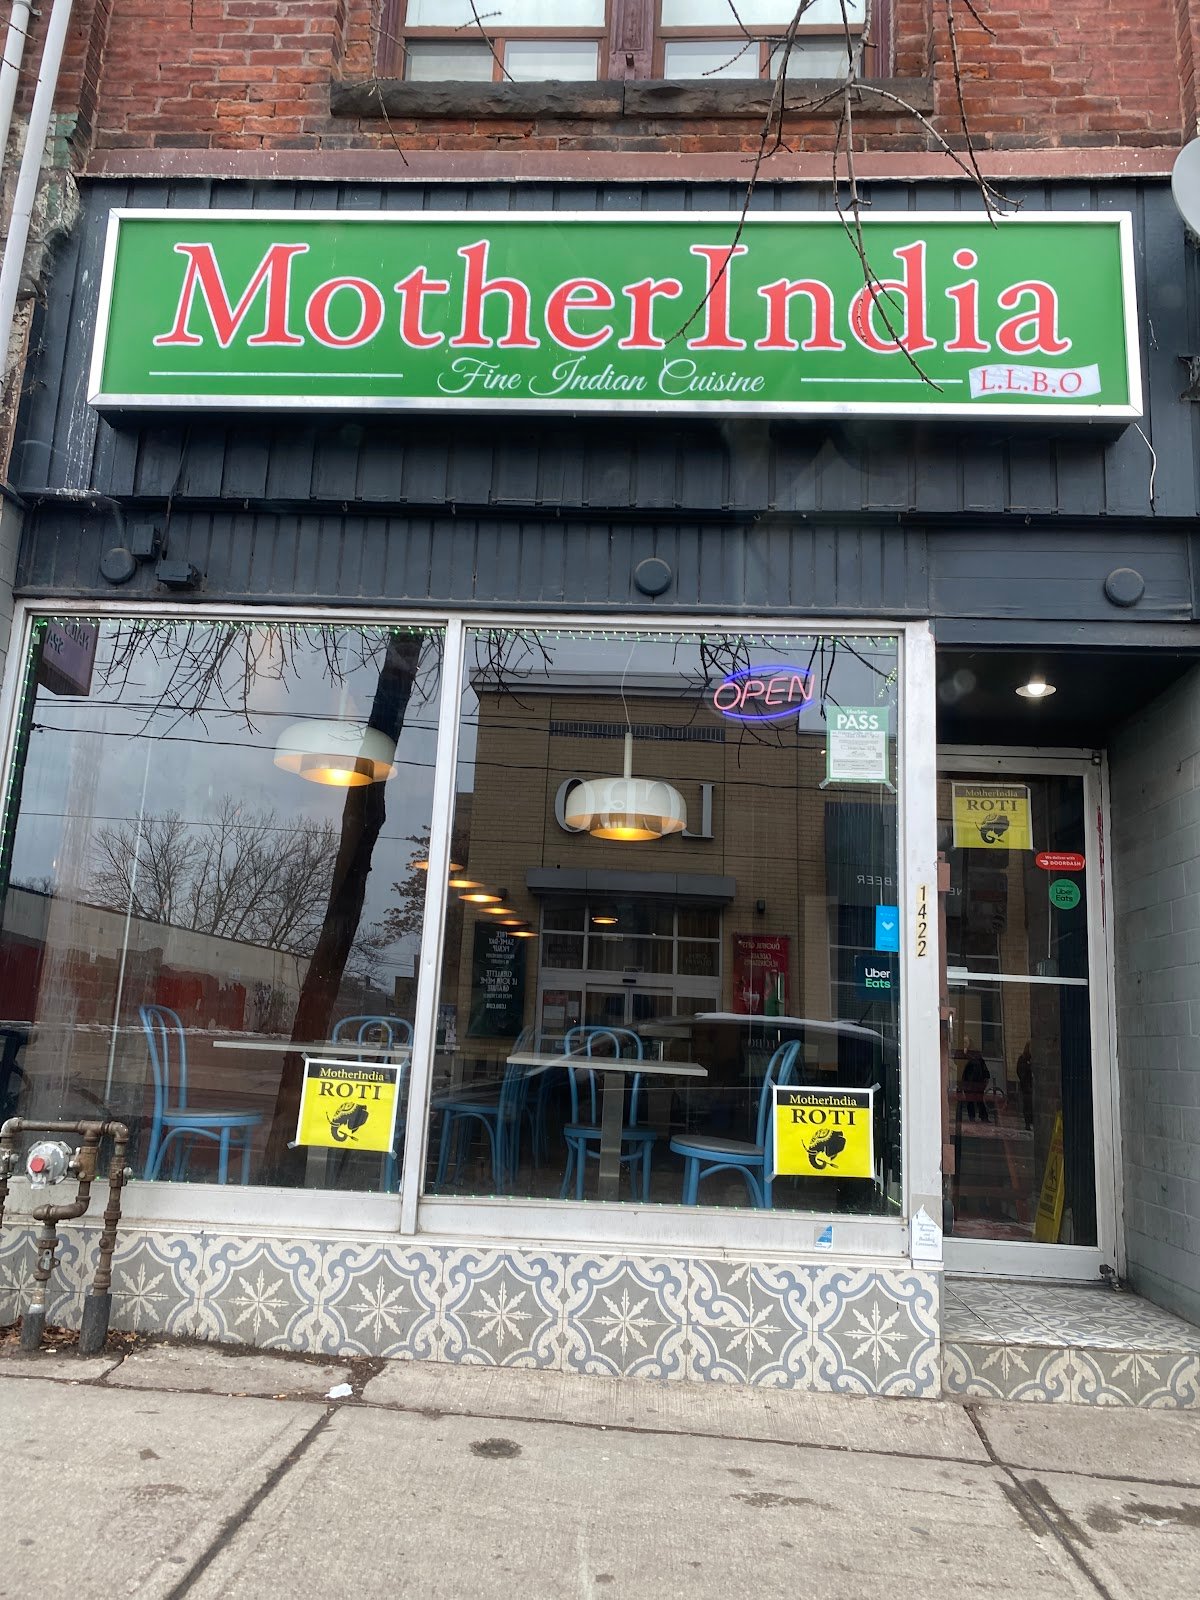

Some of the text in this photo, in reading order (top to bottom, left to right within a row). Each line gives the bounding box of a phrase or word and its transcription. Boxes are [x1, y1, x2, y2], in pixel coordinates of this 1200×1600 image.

[153, 239, 1072, 355] MotherIndia
[437, 356, 766, 396] Fine Indian Cuisine
[980, 368, 1084, 395] L.L.B.O
[714, 674, 815, 711] OPEN
[837, 714, 879, 730] PASS
[965, 788, 1018, 798] MotherIndia
[967, 799, 1018, 812] ROTI
[1055, 887, 1073, 895] Uber
[1055, 894, 1073, 902] Eats
[917, 885, 927, 957] 1422
[864, 967, 891, 979] Uber
[865, 979, 891, 989] Eats
[320, 1067, 384, 1081] MotherIndia
[319, 1080, 382, 1100] ROTI
[790, 1094, 857, 1107] MotherIndia
[791, 1108, 856, 1126] ROTI
